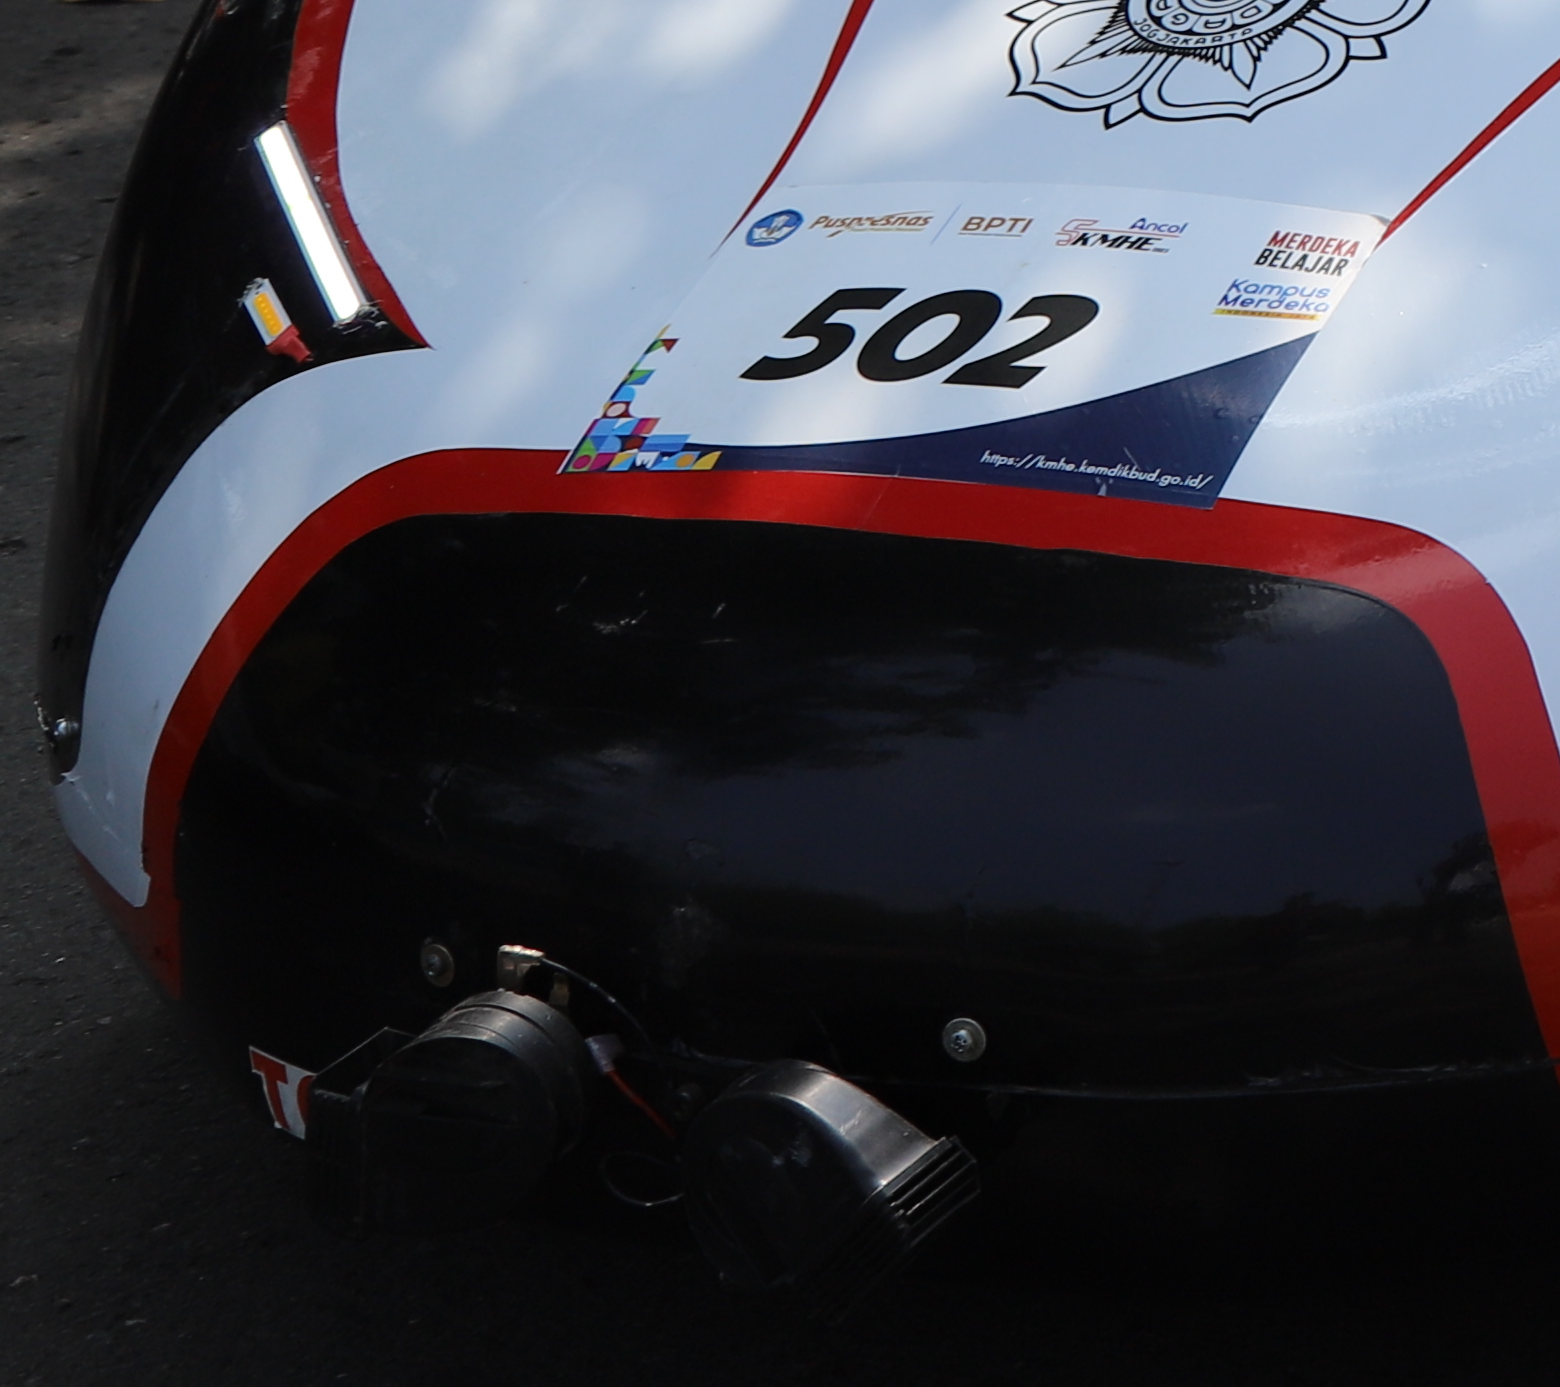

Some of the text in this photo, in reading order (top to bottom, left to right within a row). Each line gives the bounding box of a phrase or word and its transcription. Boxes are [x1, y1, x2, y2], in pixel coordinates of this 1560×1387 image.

[961, 216, 1034, 233] BPTI
[1129, 217, 1190, 234] Ancol
[1266, 230, 1361, 258] MERDEKA
[1254, 248, 1350, 277] BELAJAR
[1226, 278, 1331, 300] Kampus
[1217, 293, 1330, 313] Merdeka
[737, 287, 1101, 389] 502
